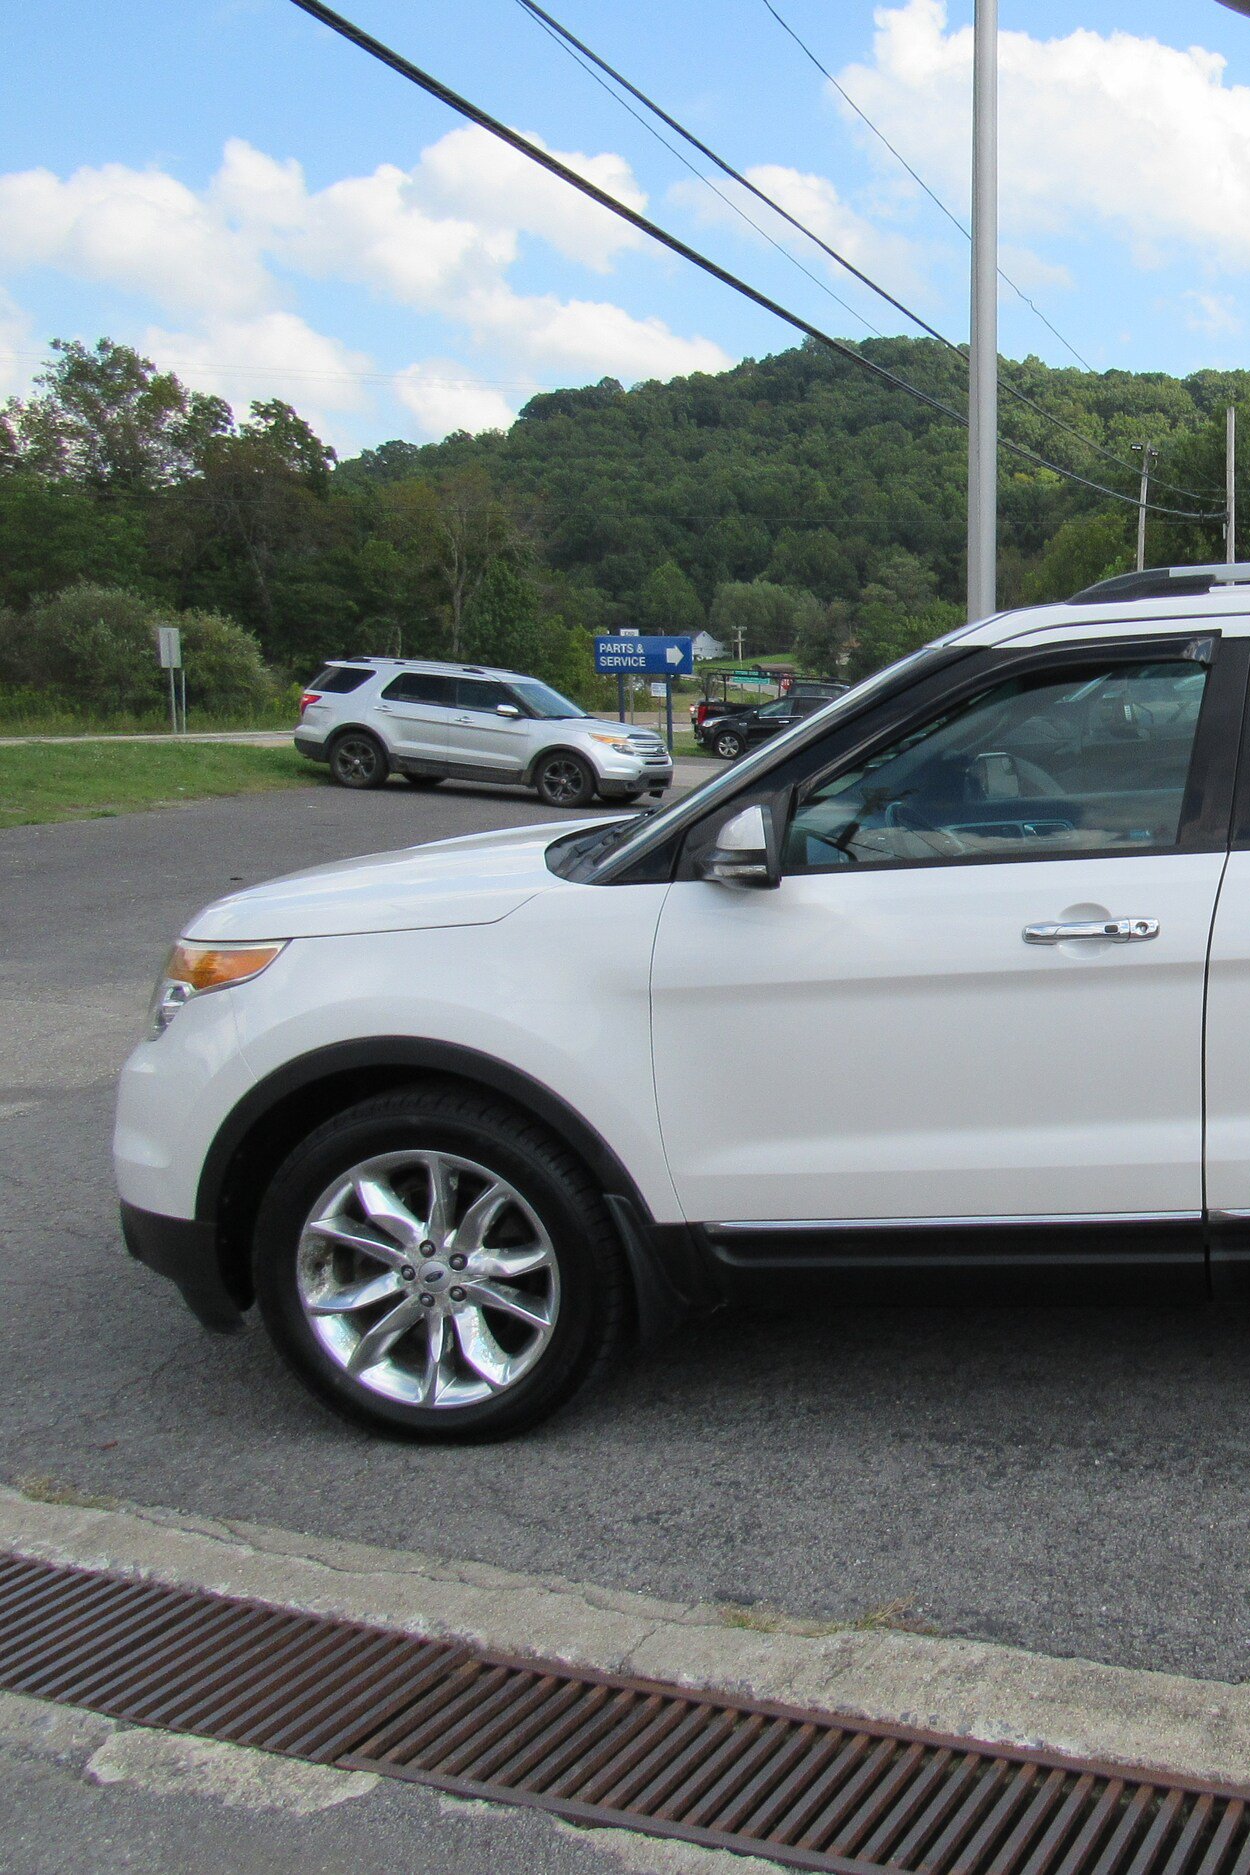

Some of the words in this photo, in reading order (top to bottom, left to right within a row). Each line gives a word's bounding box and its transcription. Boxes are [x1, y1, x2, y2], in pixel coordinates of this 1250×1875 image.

[600, 643, 634, 654] PARTS
[636, 643, 645, 654] &
[599, 656, 646, 667] SERVICE
